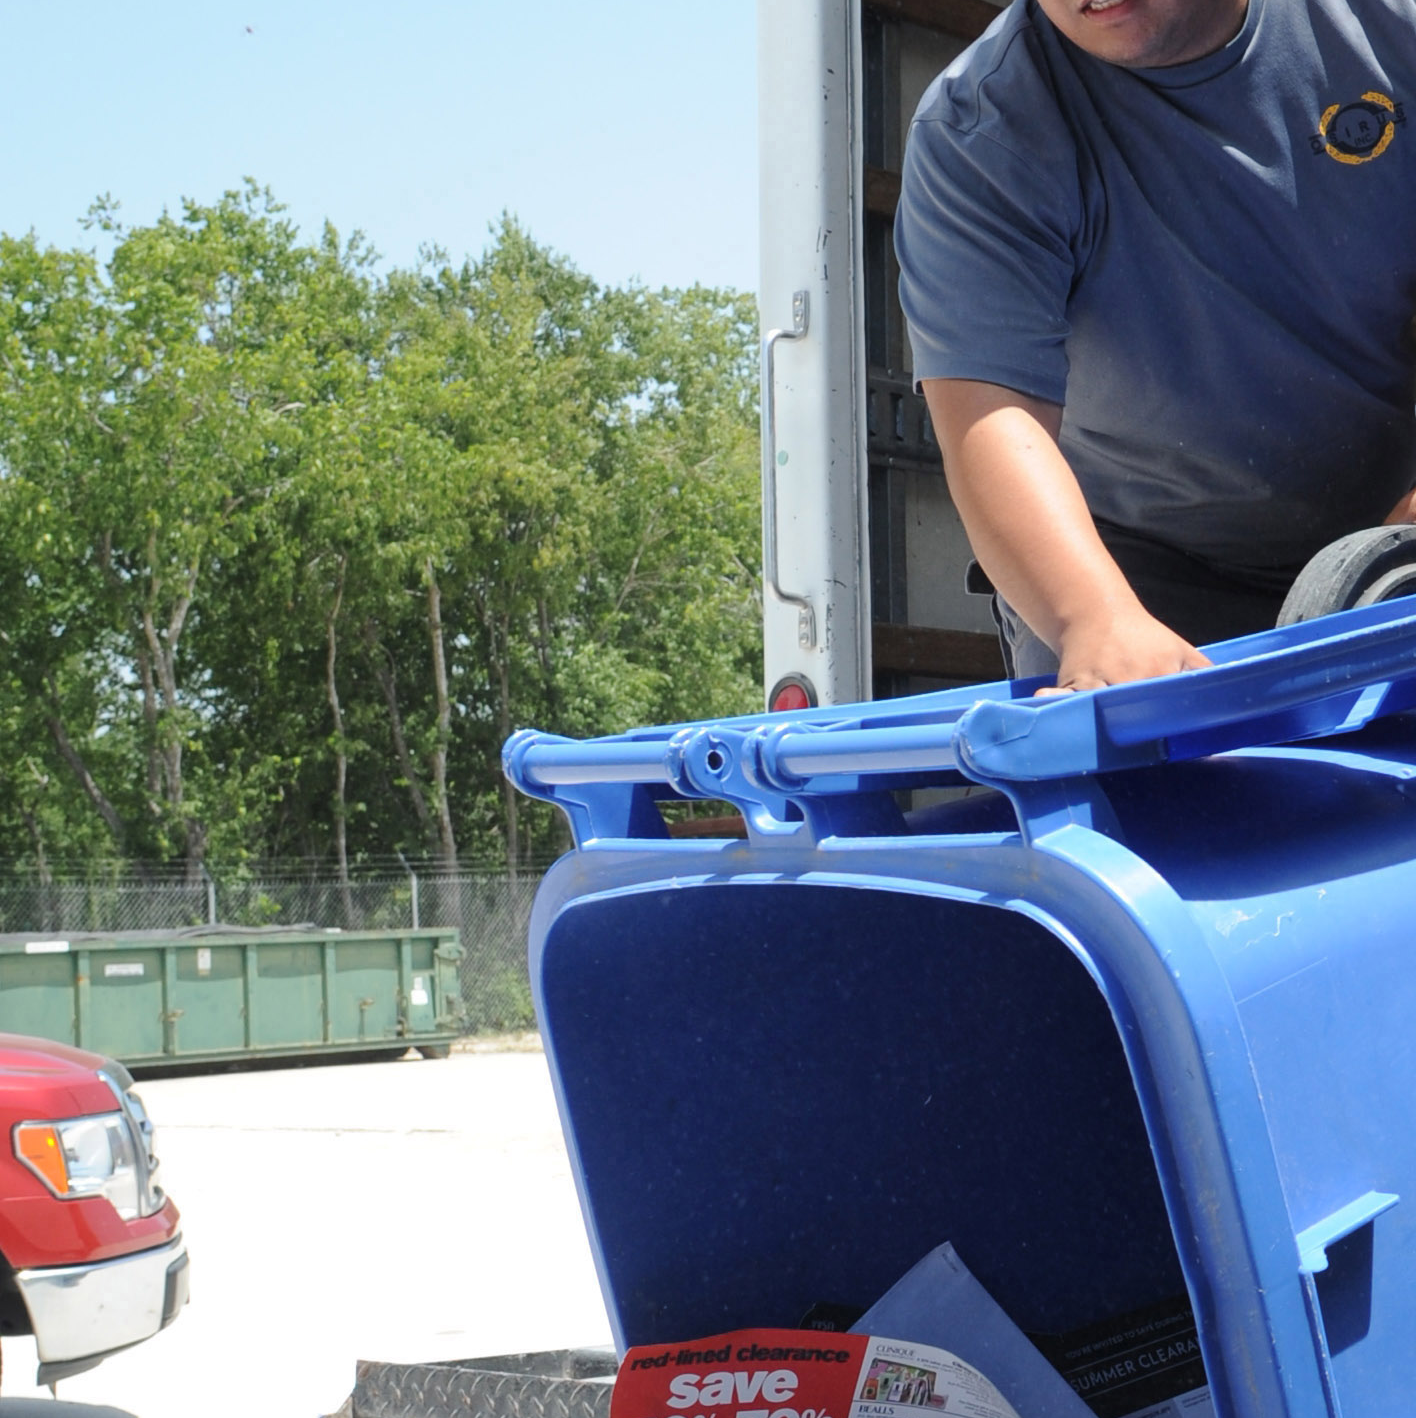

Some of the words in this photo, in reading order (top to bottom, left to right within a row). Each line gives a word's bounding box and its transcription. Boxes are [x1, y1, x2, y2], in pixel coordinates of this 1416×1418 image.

[631, 1344, 731, 1370] red-lined
[737, 1344, 850, 1363] clearance
[876, 1344, 916, 1357] CLINIQUE
[666, 1369, 798, 1409] save
[1070, 1359, 1136, 1393] SUMMER
[858, 1404, 895, 1415] BEALLS
